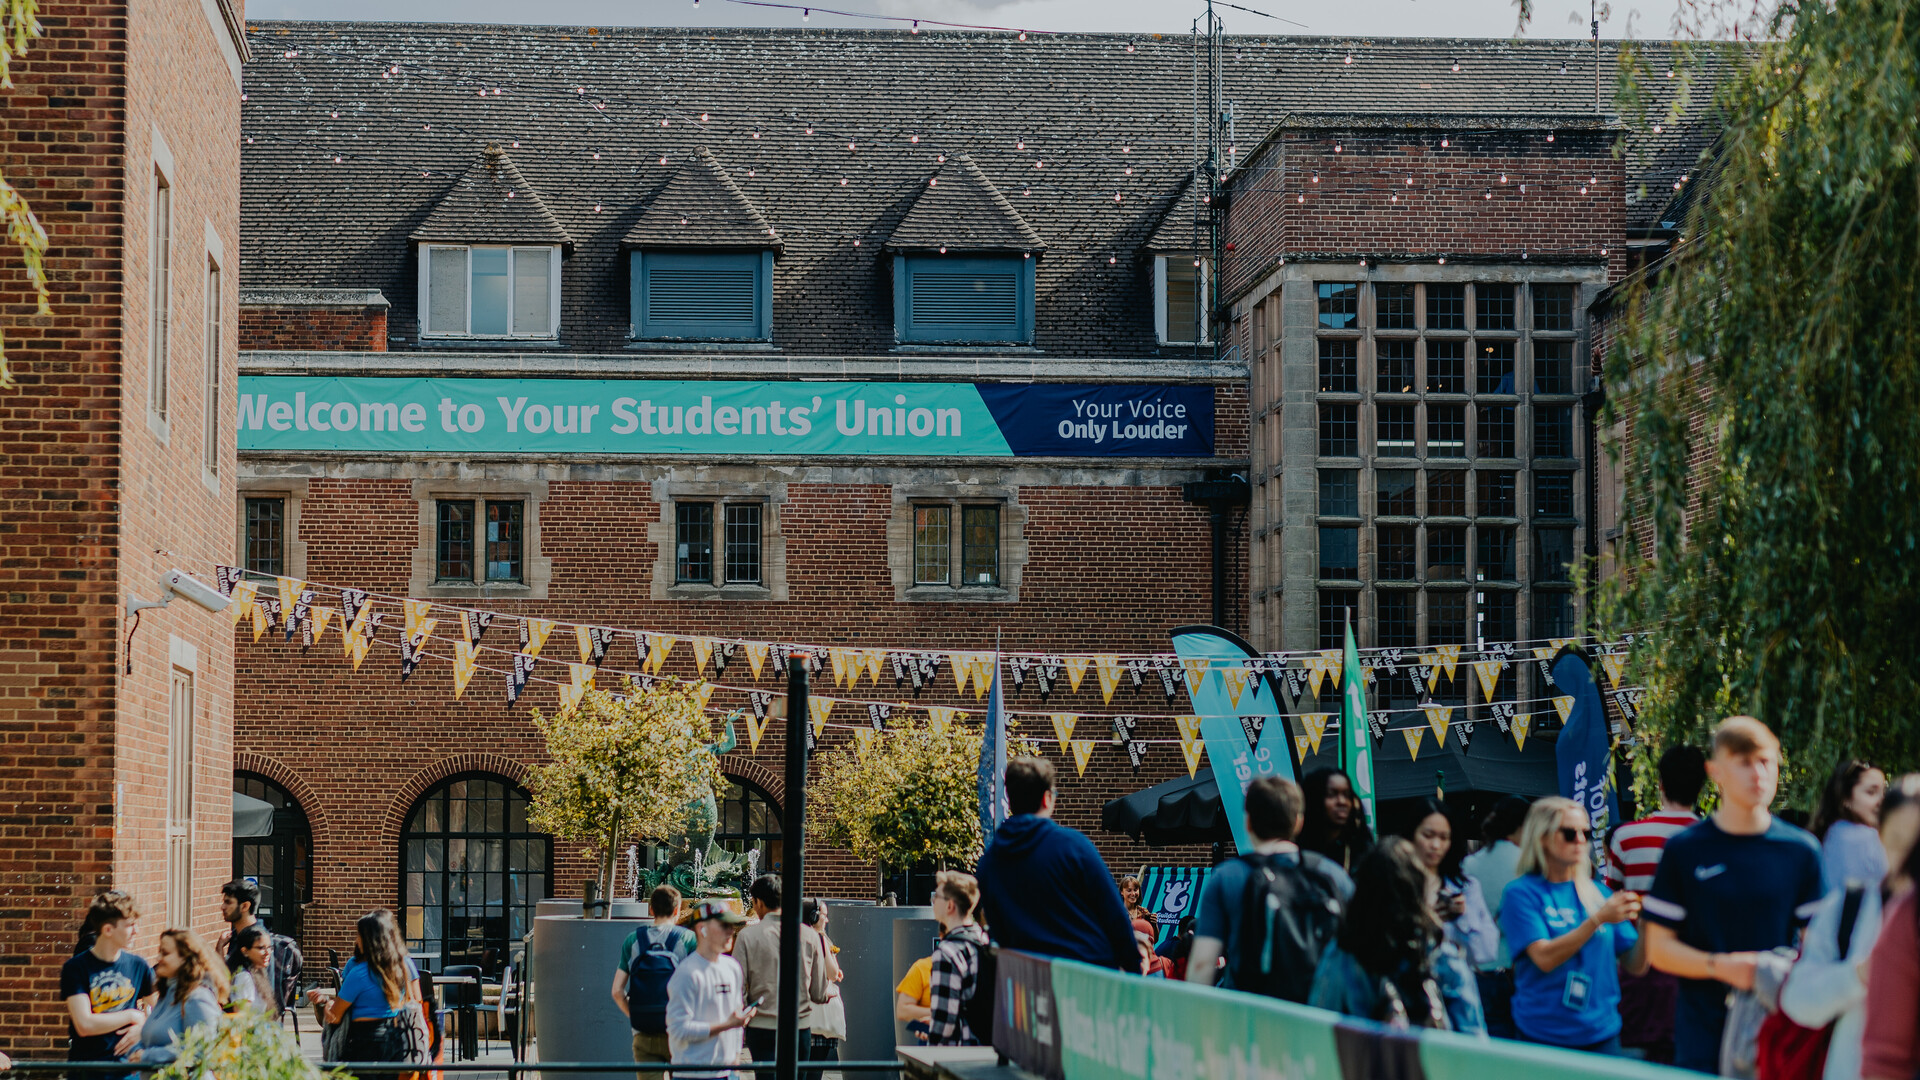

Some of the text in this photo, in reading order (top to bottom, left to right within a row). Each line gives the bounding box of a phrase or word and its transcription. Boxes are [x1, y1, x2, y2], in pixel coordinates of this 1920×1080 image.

[237, 392, 427, 432] Welcome
[437, 397, 486, 433] to
[496, 396, 600, 434] Your
[836, 394, 962, 437] Union
[1072, 398, 1187, 418] Your Voice
[1058, 419, 1188, 444] Only Louder
[261, 601, 276, 627] WELCOME
[342, 591, 354, 620] WELCOME
[469, 612, 480, 640] WELCOME
[400, 632, 412, 660] WELCOME
[590, 629, 604, 658] WELCOME
[514, 656, 525, 684] WELCOME
[908, 660, 922, 688] WELCOME
[1036, 666, 1050, 694] WELCOME
[1161, 669, 1175, 696] WELCOME
[1286, 670, 1301, 697] WELCOME
[1408, 666, 1424, 694] WELCOME
[506, 675, 516, 700] WELCOME
[750, 693, 764, 718] WELCOME
[1491, 704, 1510, 733] WELCOME
[1615, 692, 1634, 720] WELCOME
[1114, 716, 1130, 742] WELCOME
[1240, 717, 1258, 744] WELCOME
[1367, 713, 1384, 740] WELCOME
[1455, 724, 1470, 747] WELCOME
[1128, 743, 1140, 767] WELCOME
